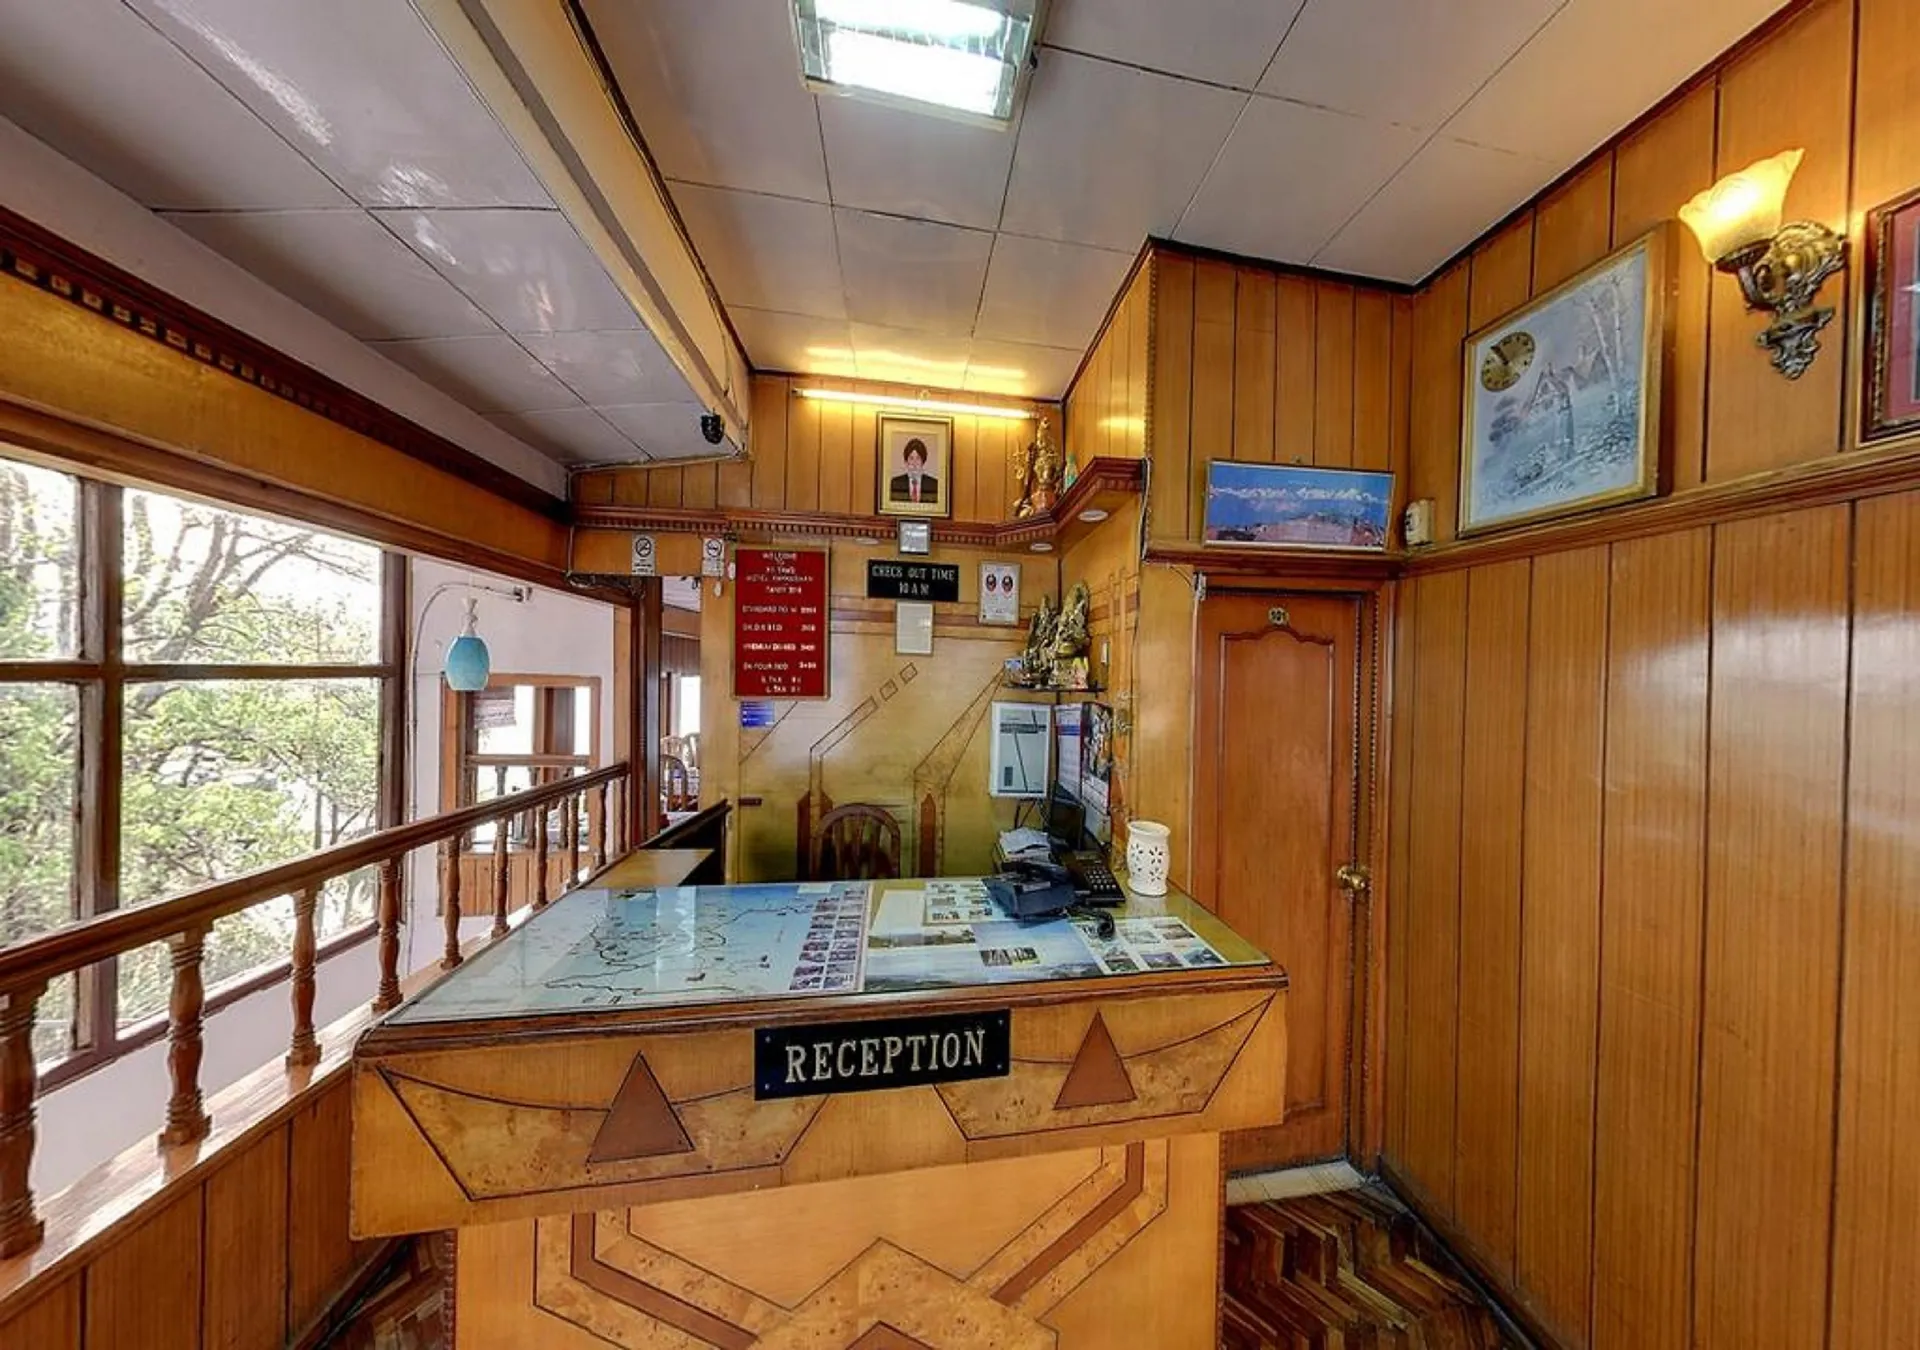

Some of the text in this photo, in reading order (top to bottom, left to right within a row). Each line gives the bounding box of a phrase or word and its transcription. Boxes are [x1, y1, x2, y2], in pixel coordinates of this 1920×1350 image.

[872, 565, 955, 581] CHECK OUT TIME
[785, 1029, 986, 1084] RECEPTION
